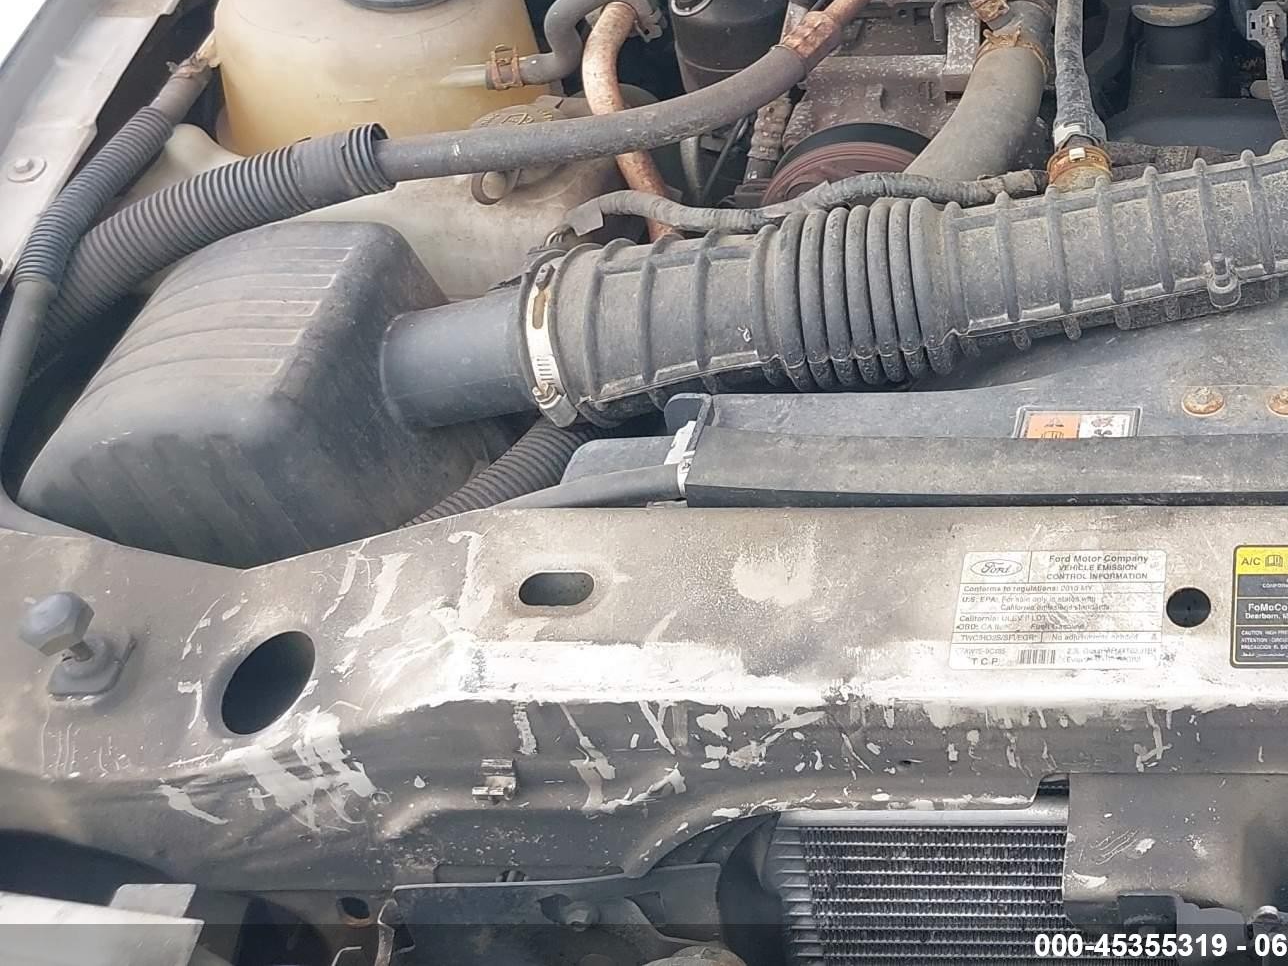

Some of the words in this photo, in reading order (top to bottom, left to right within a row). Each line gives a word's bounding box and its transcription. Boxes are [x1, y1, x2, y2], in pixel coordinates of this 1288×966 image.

[1049, 554, 1071, 563] Ford
[1073, 554, 1102, 563] Motor
[1103, 554, 1148, 564] Company
[1241, 557, 1261, 566] A/C
[980, 561, 1012, 574] Ford
[1096, 563, 1137, 571] EMISSION
[1089, 572, 1148, 580] INFORMATION
[1248, 603, 1288, 612] FoMoCo
